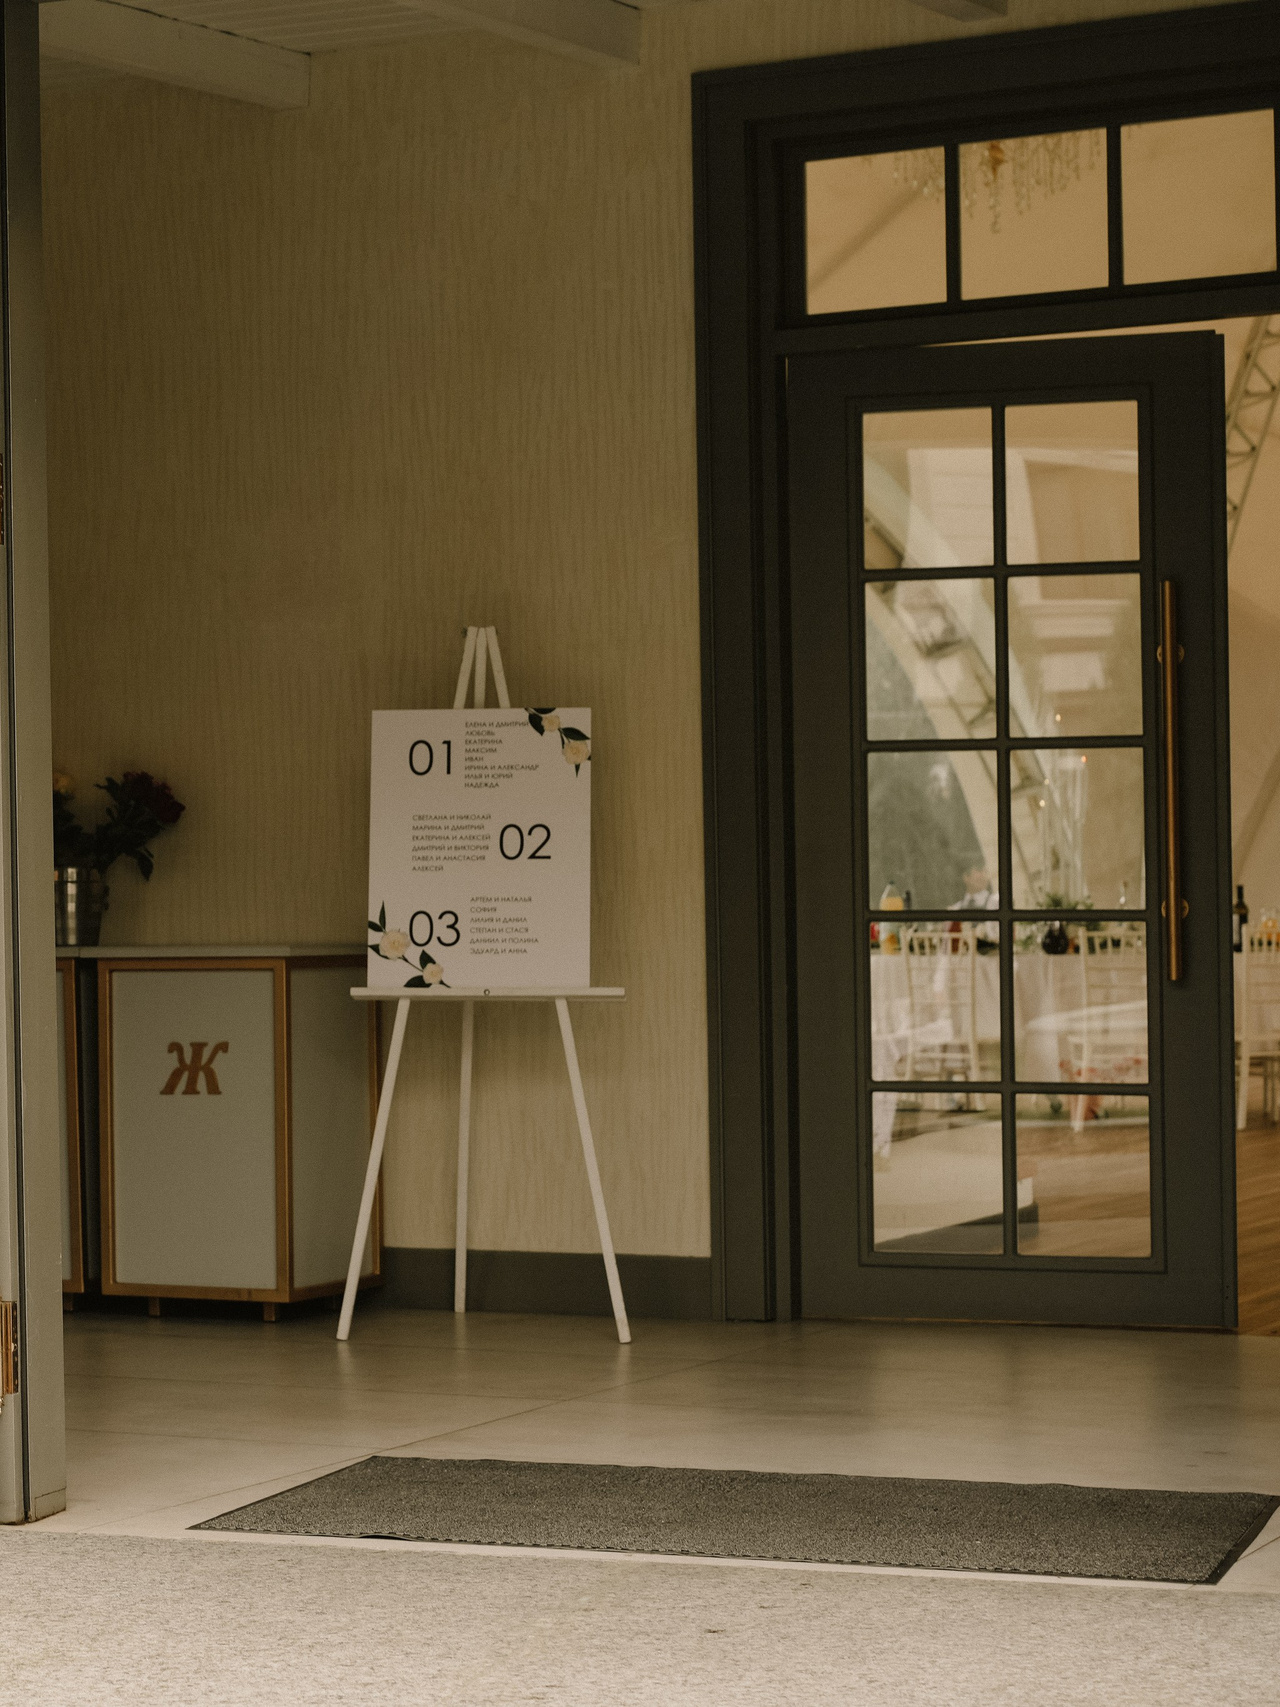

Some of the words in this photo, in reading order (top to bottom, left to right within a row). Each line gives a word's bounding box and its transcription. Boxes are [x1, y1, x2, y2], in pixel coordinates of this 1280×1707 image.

[409, 740, 452, 776] 01
[499, 823, 552, 860] 02
[409, 910, 461, 947] 03
[159, 1041, 230, 1096] Ж
